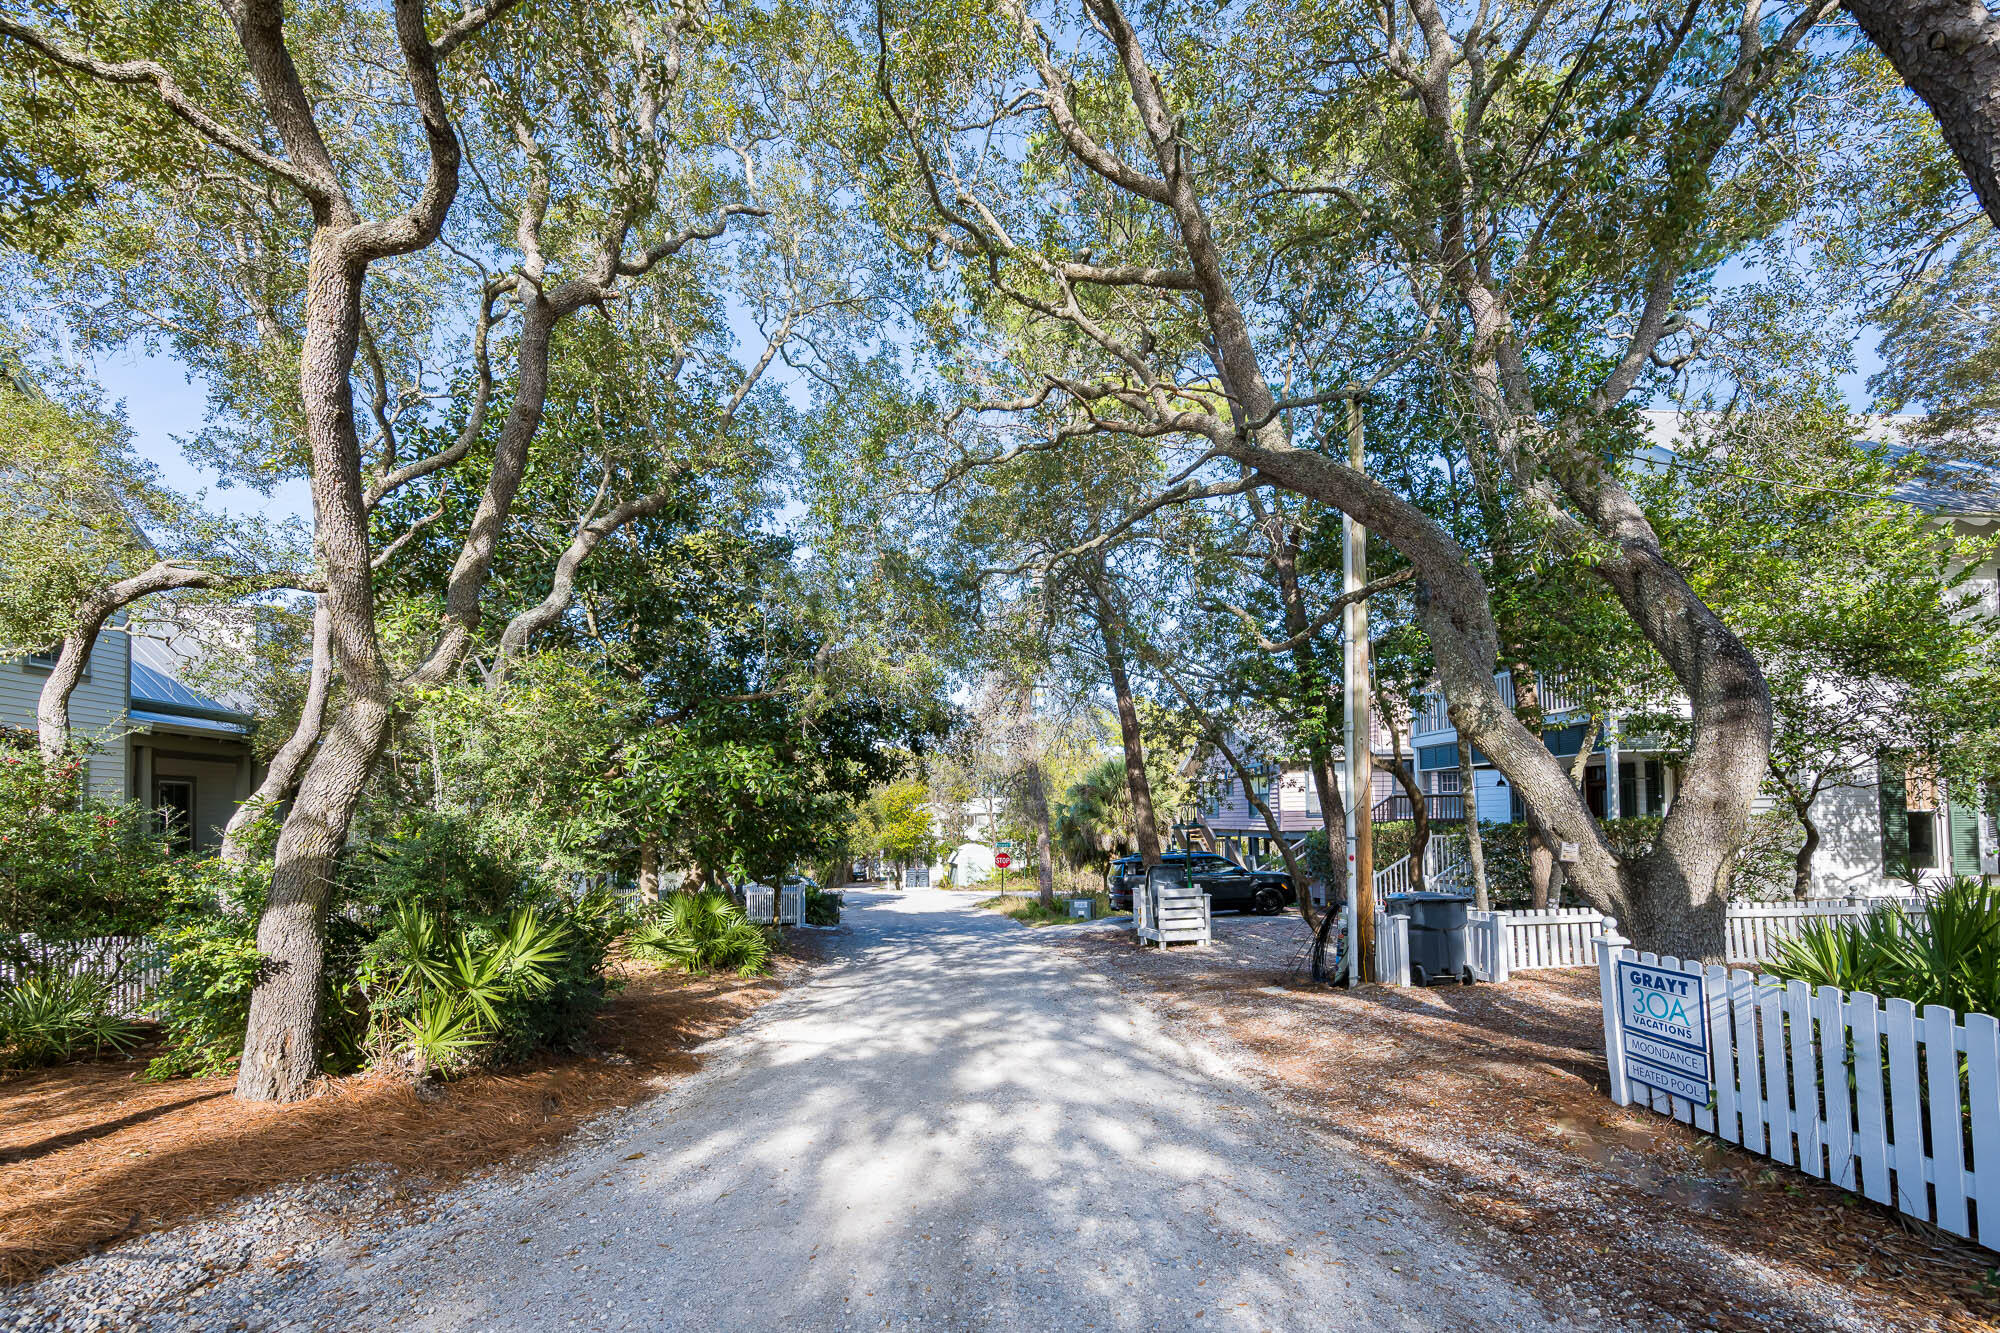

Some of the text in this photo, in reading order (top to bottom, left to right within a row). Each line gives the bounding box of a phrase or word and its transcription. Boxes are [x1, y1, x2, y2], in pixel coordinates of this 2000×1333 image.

[1630, 970, 1688, 996] GRAYT
[1632, 988, 1690, 1026] 30A
[1633, 1014, 1692, 1039] VACATIONS
[1632, 1039, 1698, 1069] MOONDANCE
[1632, 1065, 1700, 1098] HEATED POOL
